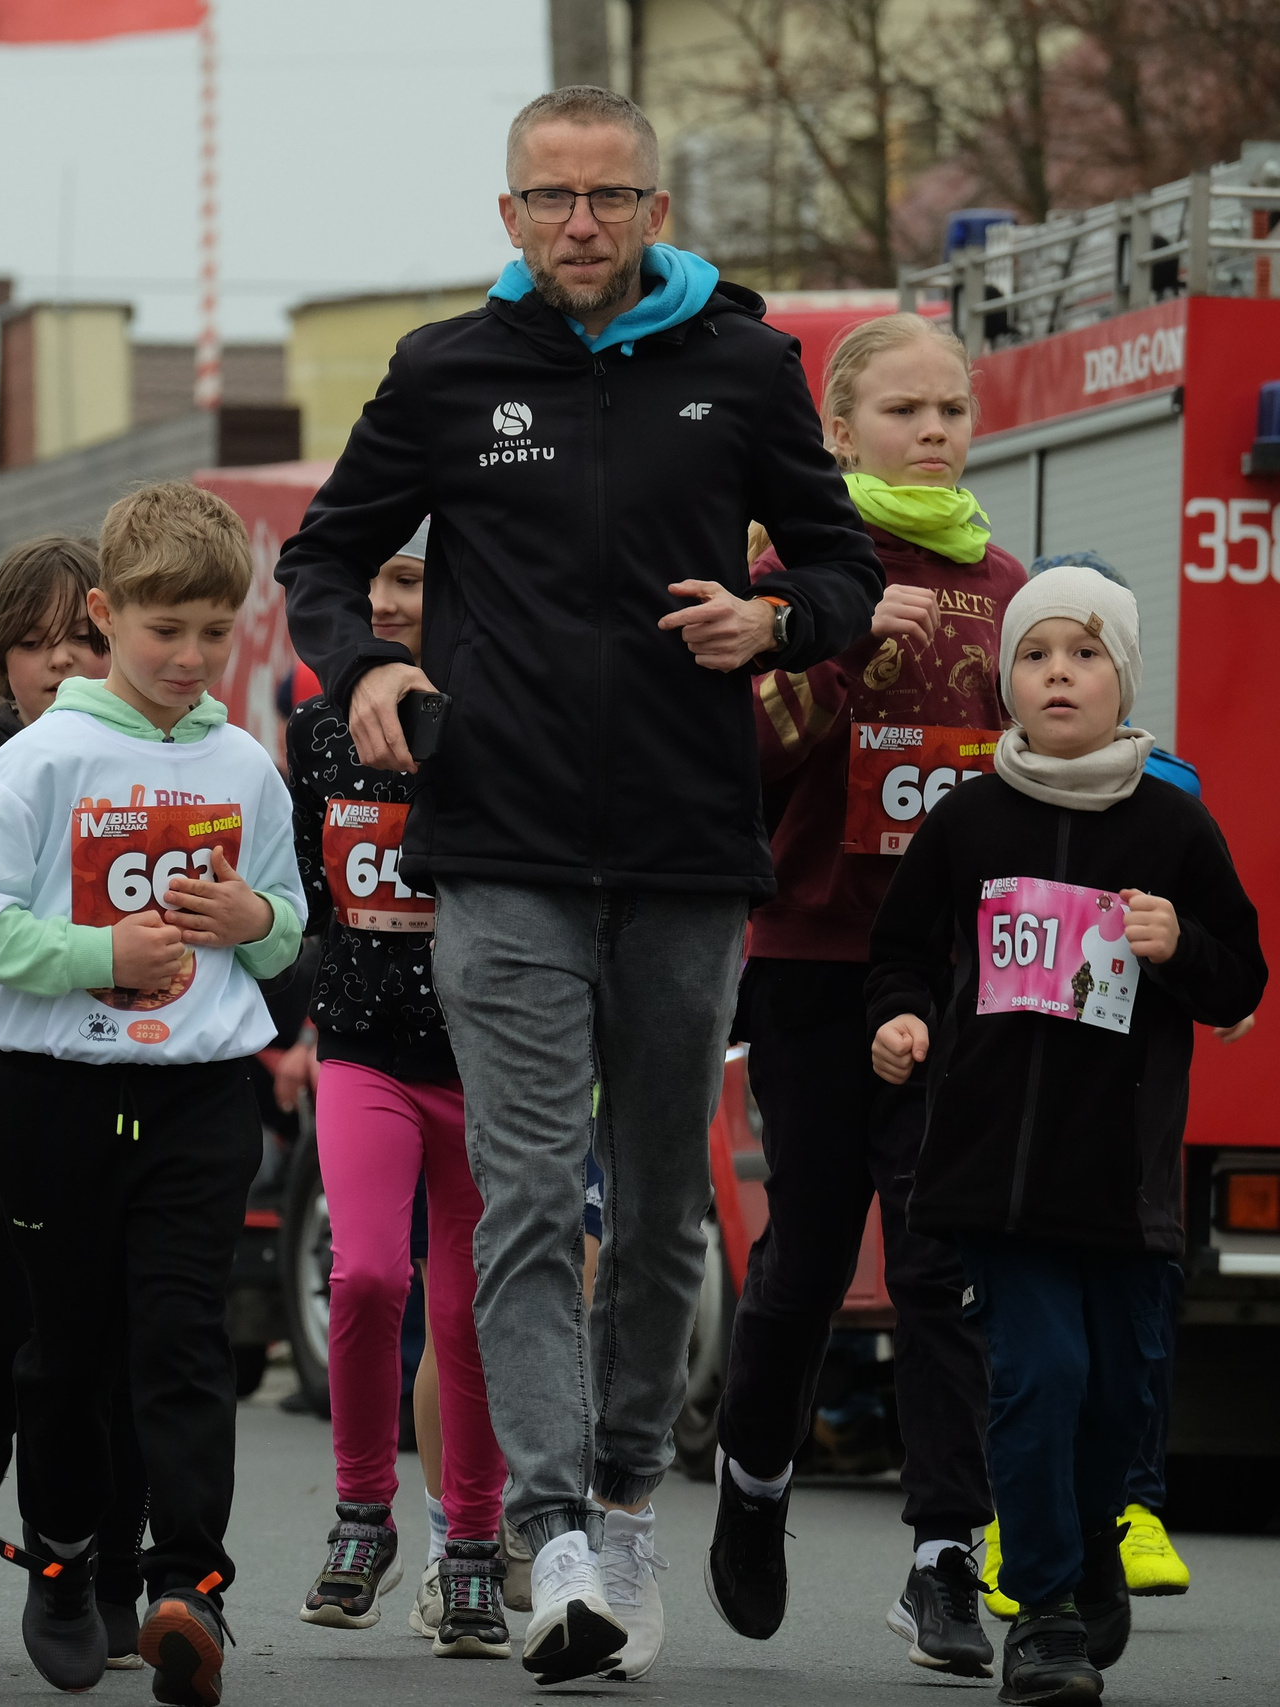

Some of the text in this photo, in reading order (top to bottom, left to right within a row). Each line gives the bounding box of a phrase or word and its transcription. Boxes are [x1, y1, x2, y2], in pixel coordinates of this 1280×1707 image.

[1082, 325, 1185, 395] DRAGON
[679, 402, 713, 420] 4F
[493, 439, 532, 449] ATELIER
[479, 447, 555, 467] SPORTU
[1184, 497, 1280, 584] 35
[859, 725, 923, 750] IV BIEG
[882, 738, 923, 746] STRAŻAKA
[959, 742, 997, 757] BIEG DZIE
[882, 764, 983, 821] 66
[80, 811, 148, 838] IV BIEG
[329, 803, 352, 827] IV
[349, 805, 379, 818] BIEG
[105, 823, 148, 831] STRAŻAKA
[188, 815, 242, 837] BIEG DZIECI
[346, 842, 435, 898] 64
[996, 877, 1018, 888] BIEG
[992, 913, 1060, 970] 561
[1041, 999, 1070, 1013] MDP
[136, 1031, 160, 1040] 2025
